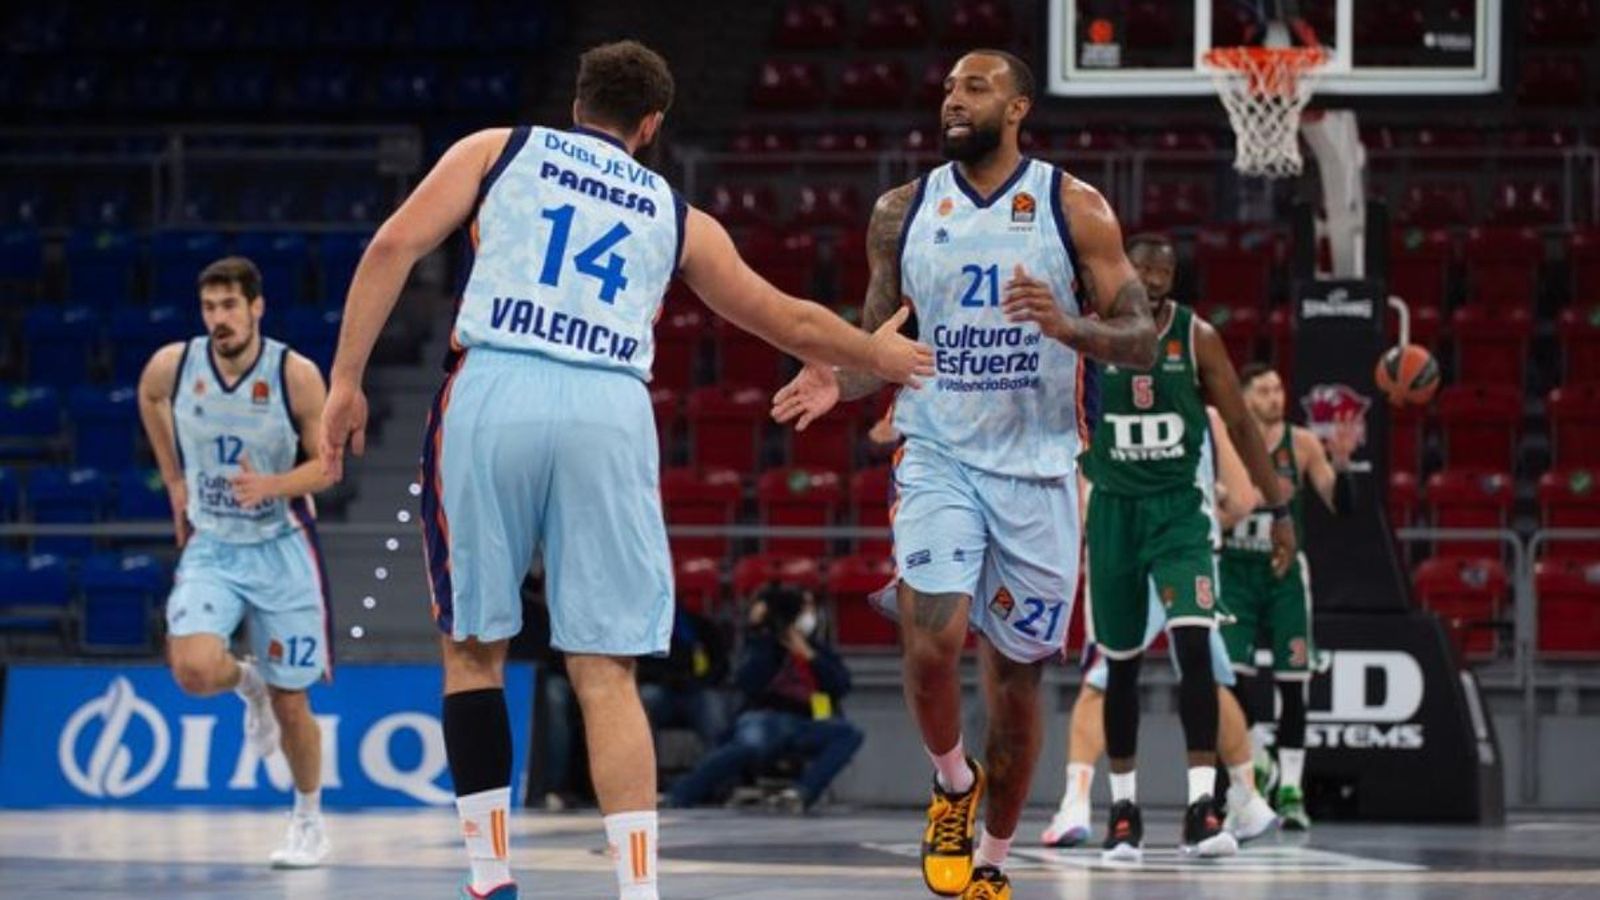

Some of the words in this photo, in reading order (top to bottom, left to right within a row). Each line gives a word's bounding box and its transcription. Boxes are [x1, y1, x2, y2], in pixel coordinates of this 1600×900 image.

[540, 161, 656, 218] PAMESA
[538, 203, 632, 305] 14
[961, 264, 999, 307] 21
[490, 297, 638, 363] VALENCIA
[934, 324, 1022, 348] Cultura
[936, 350, 1039, 375] Esfuerzo
[1132, 375, 1153, 408] 5
[1104, 412, 1185, 448] TD
[214, 435, 243, 465] 12
[1014, 596, 1065, 641] 21
[286, 636, 316, 667] 12
